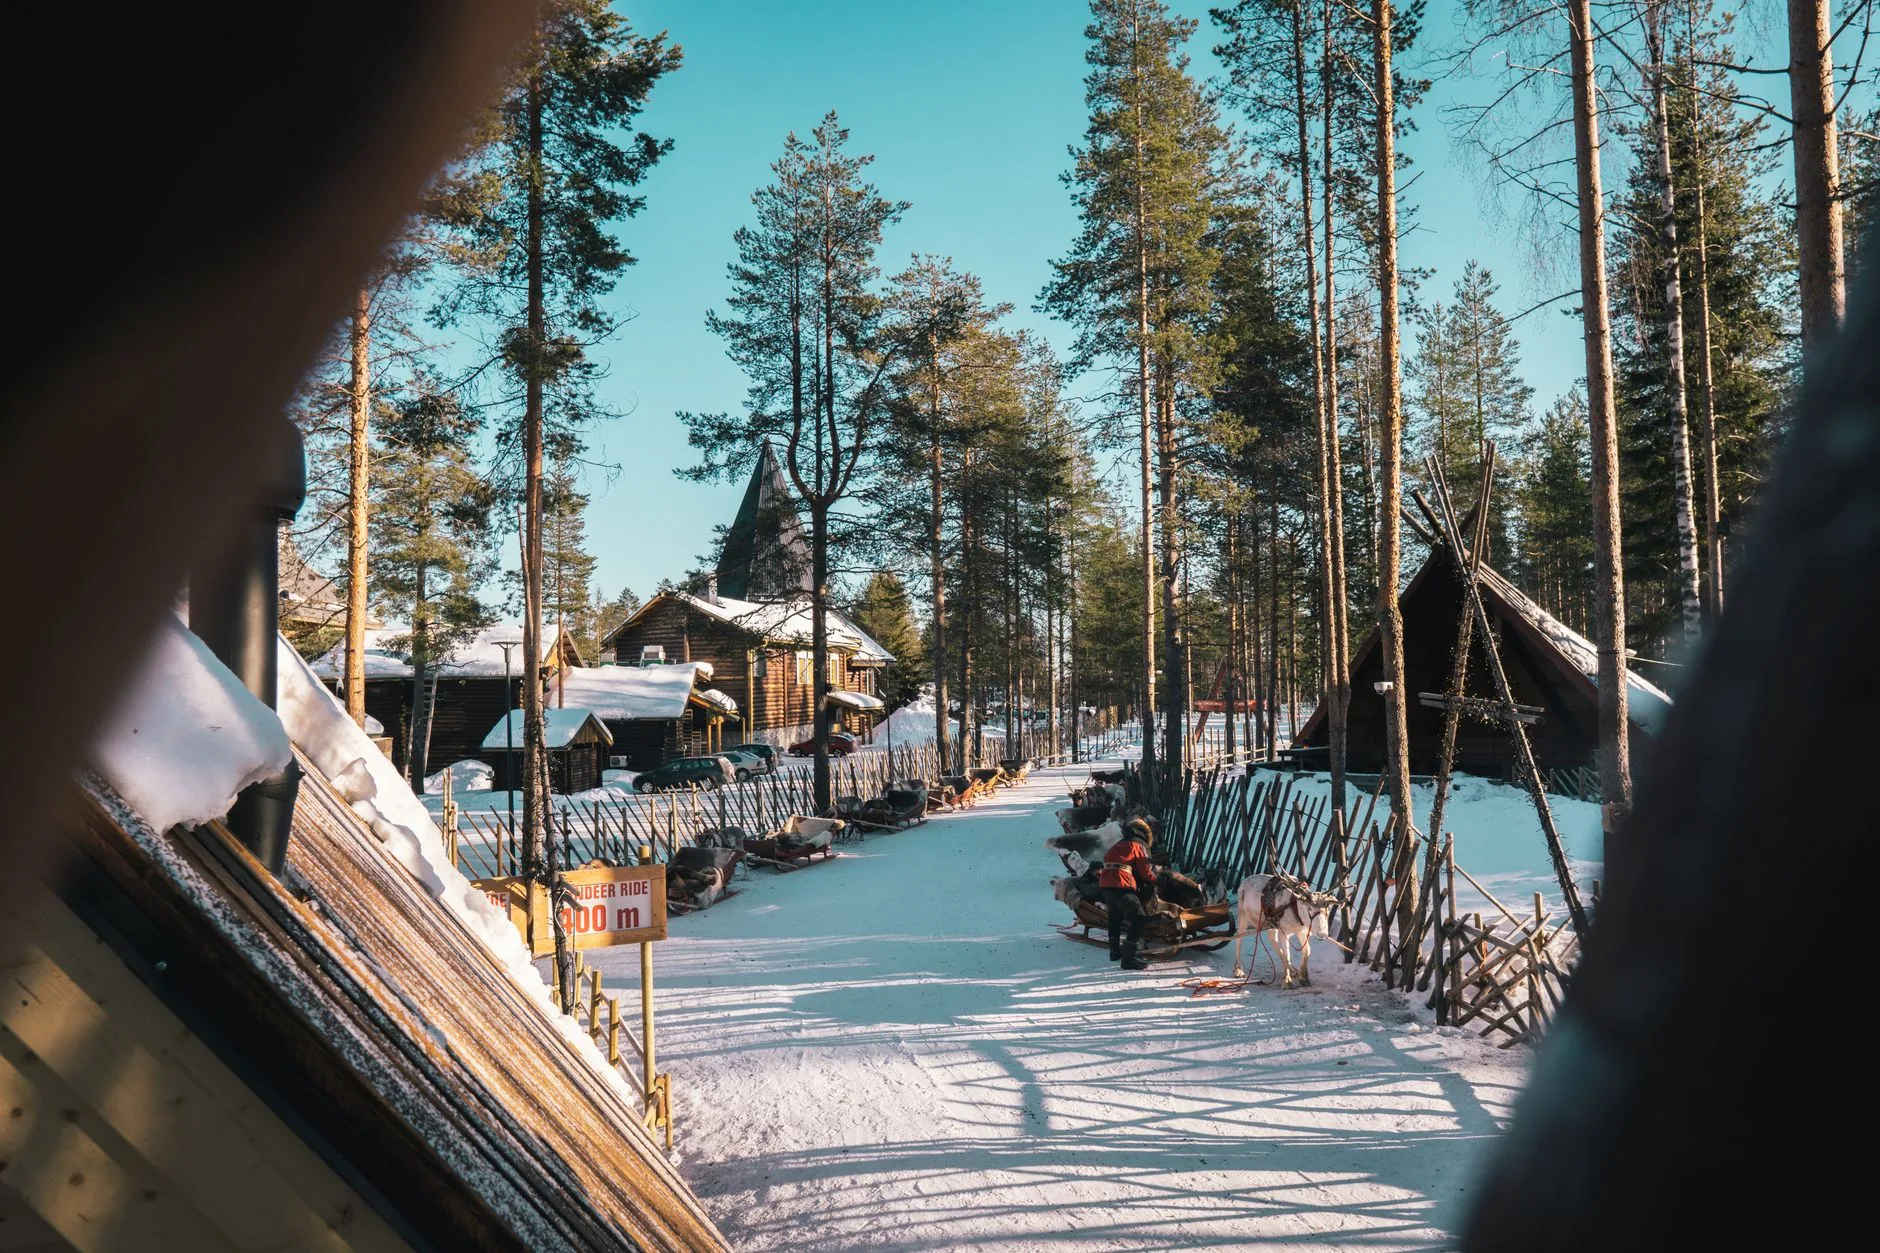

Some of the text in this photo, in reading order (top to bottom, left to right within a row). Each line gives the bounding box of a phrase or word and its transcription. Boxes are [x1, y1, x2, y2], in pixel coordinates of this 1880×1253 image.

[573, 881, 648, 900] NDEER RIDE
[561, 904, 639, 935] 400 m
